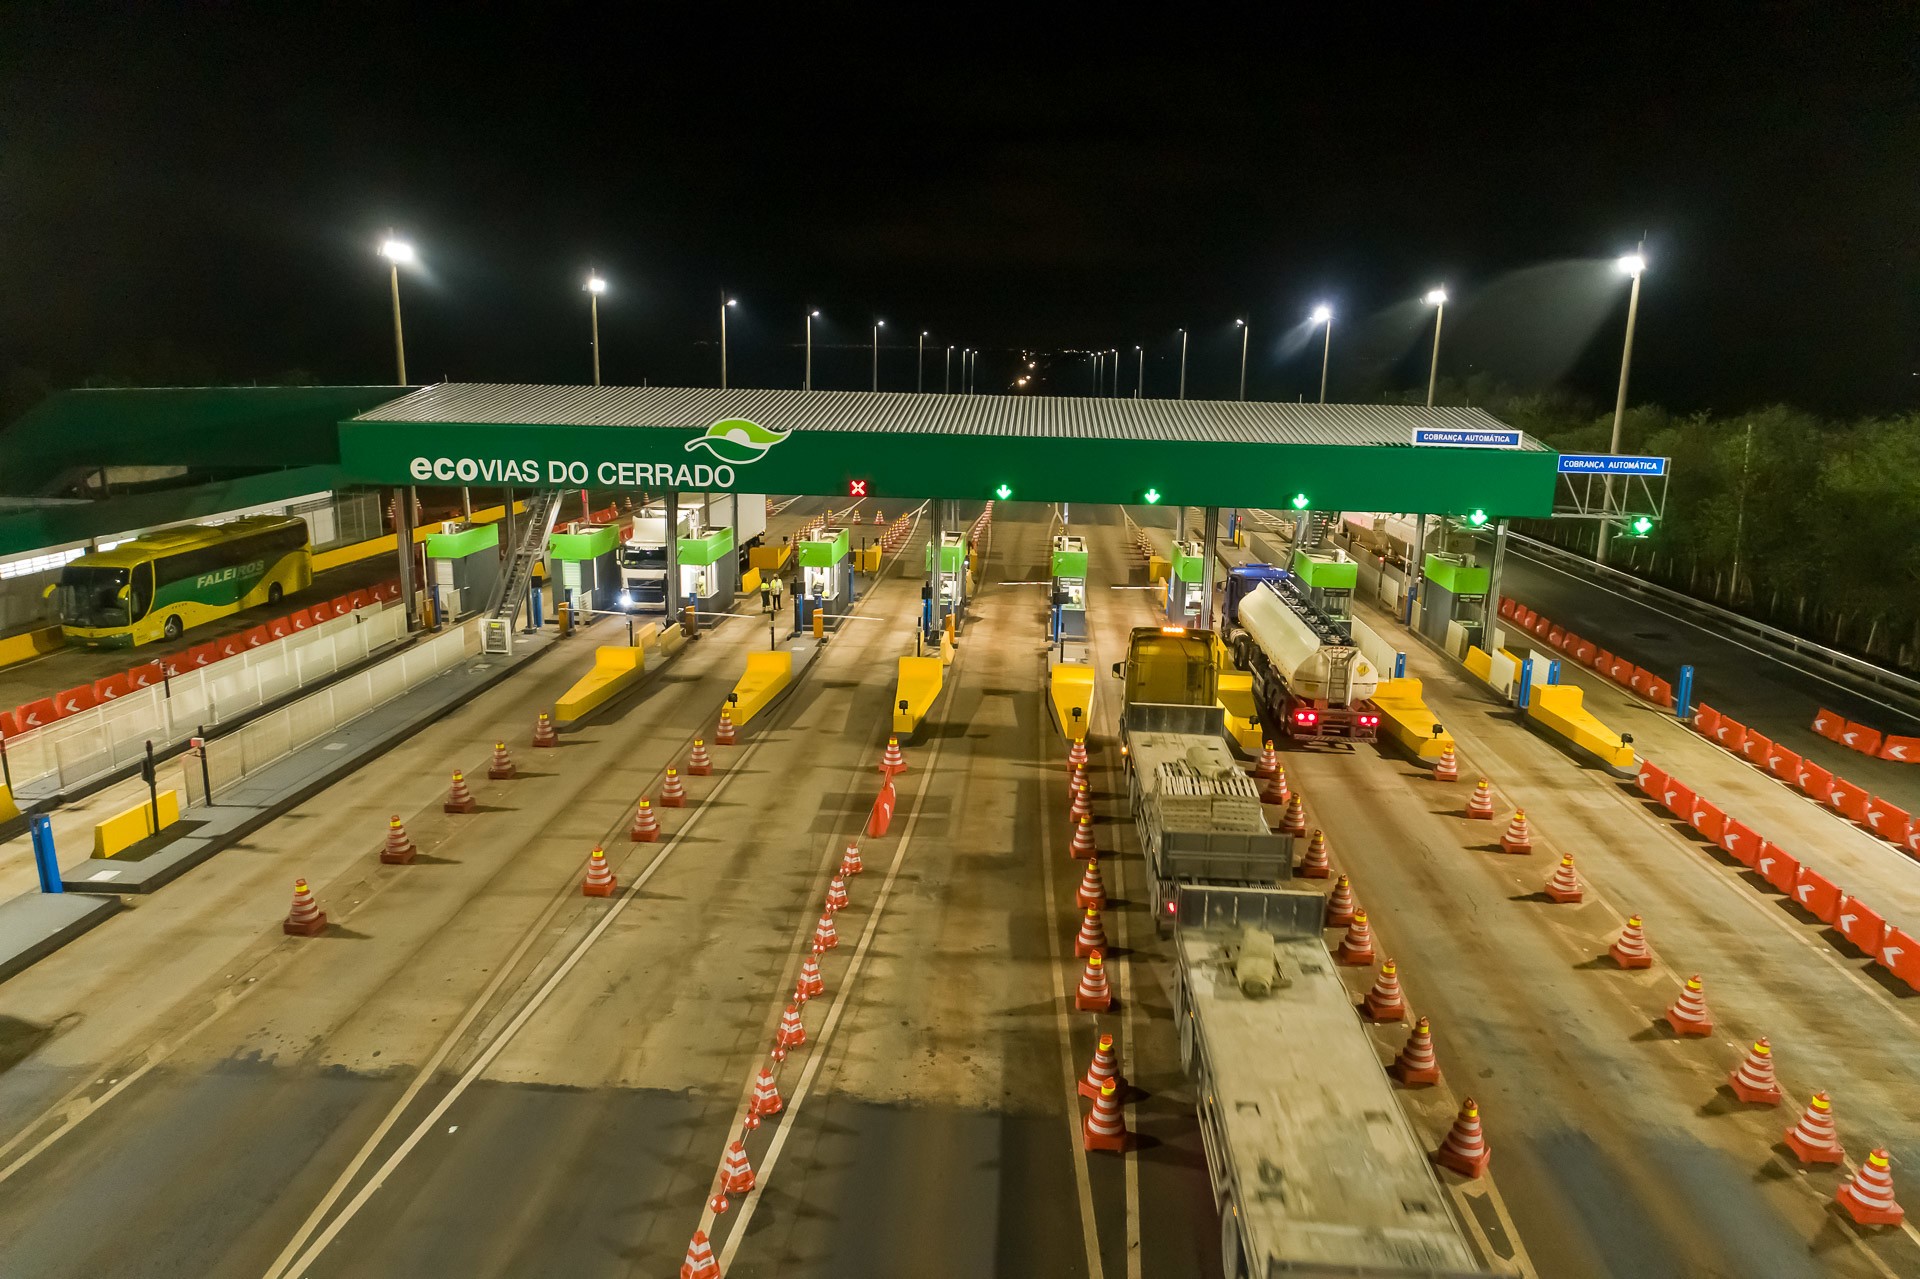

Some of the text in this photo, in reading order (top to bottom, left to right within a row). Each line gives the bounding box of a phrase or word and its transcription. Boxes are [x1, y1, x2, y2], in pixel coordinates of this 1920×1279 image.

[1423, 433, 1510, 443] COBRANÇA AUTOMÁTICA
[409, 457, 735, 488] ecoVIAS DO CERRADO
[1563, 460, 1657, 470] COBRANÇA AUTOMÁTICA
[196, 560, 265, 589] FALEIROS
